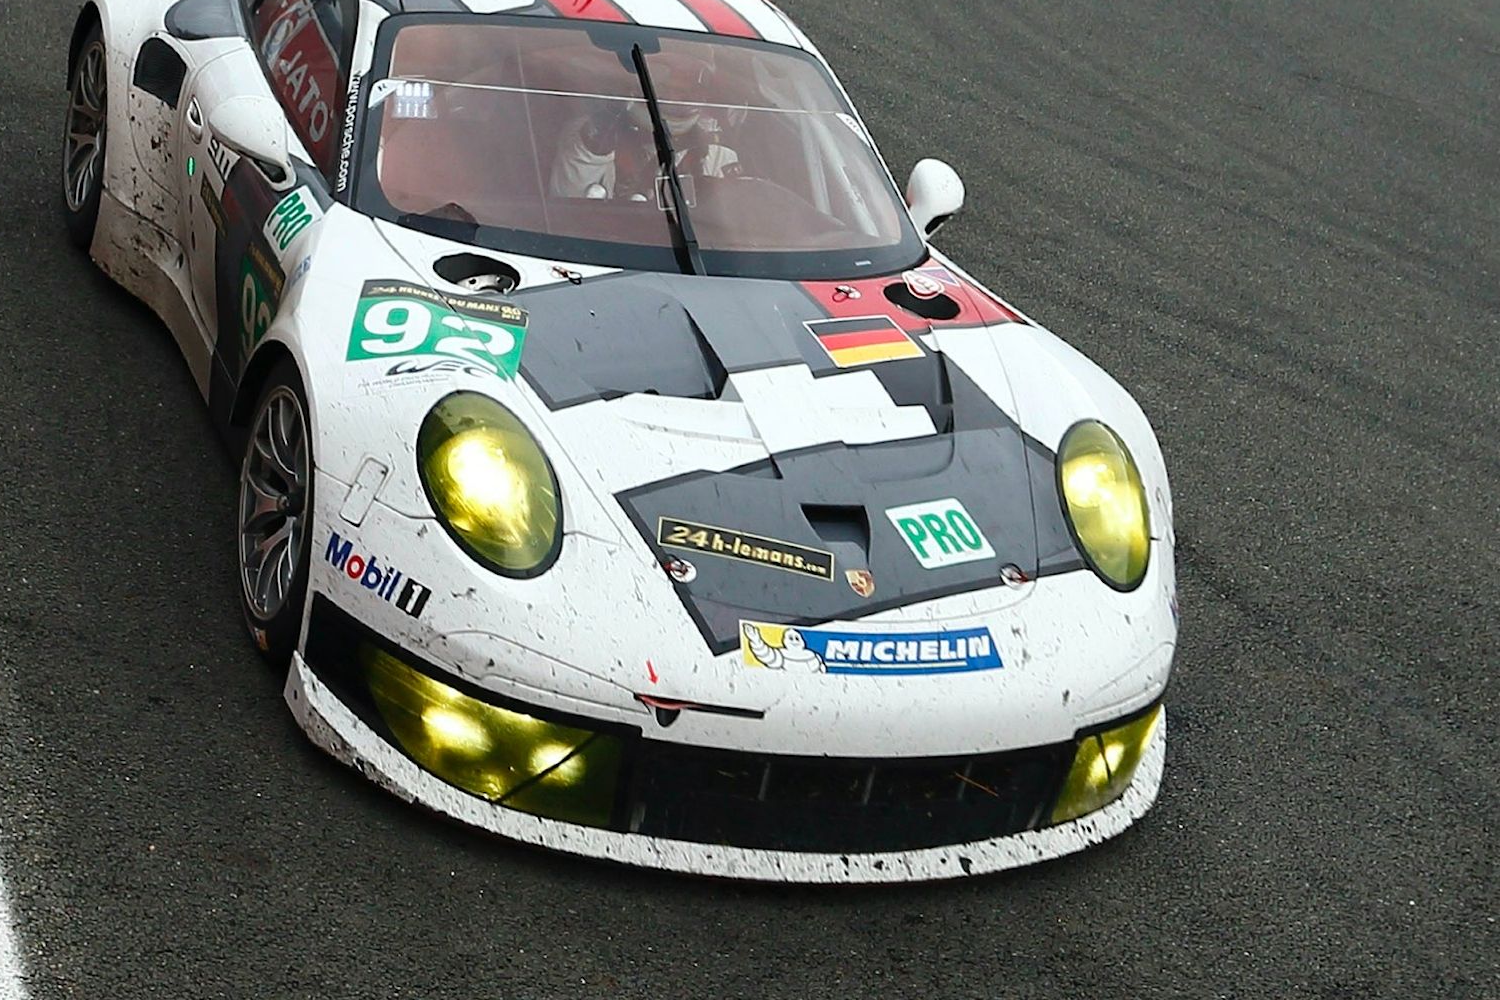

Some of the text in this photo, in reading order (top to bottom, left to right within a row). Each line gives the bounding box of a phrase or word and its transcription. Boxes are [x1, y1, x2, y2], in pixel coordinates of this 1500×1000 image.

[266, 191, 313, 251] PRO
[360, 299, 516, 375] 92
[896, 509, 983, 559] PRO
[325, 531, 403, 603] Mobil
[825, 635, 991, 663] MICHELIN
